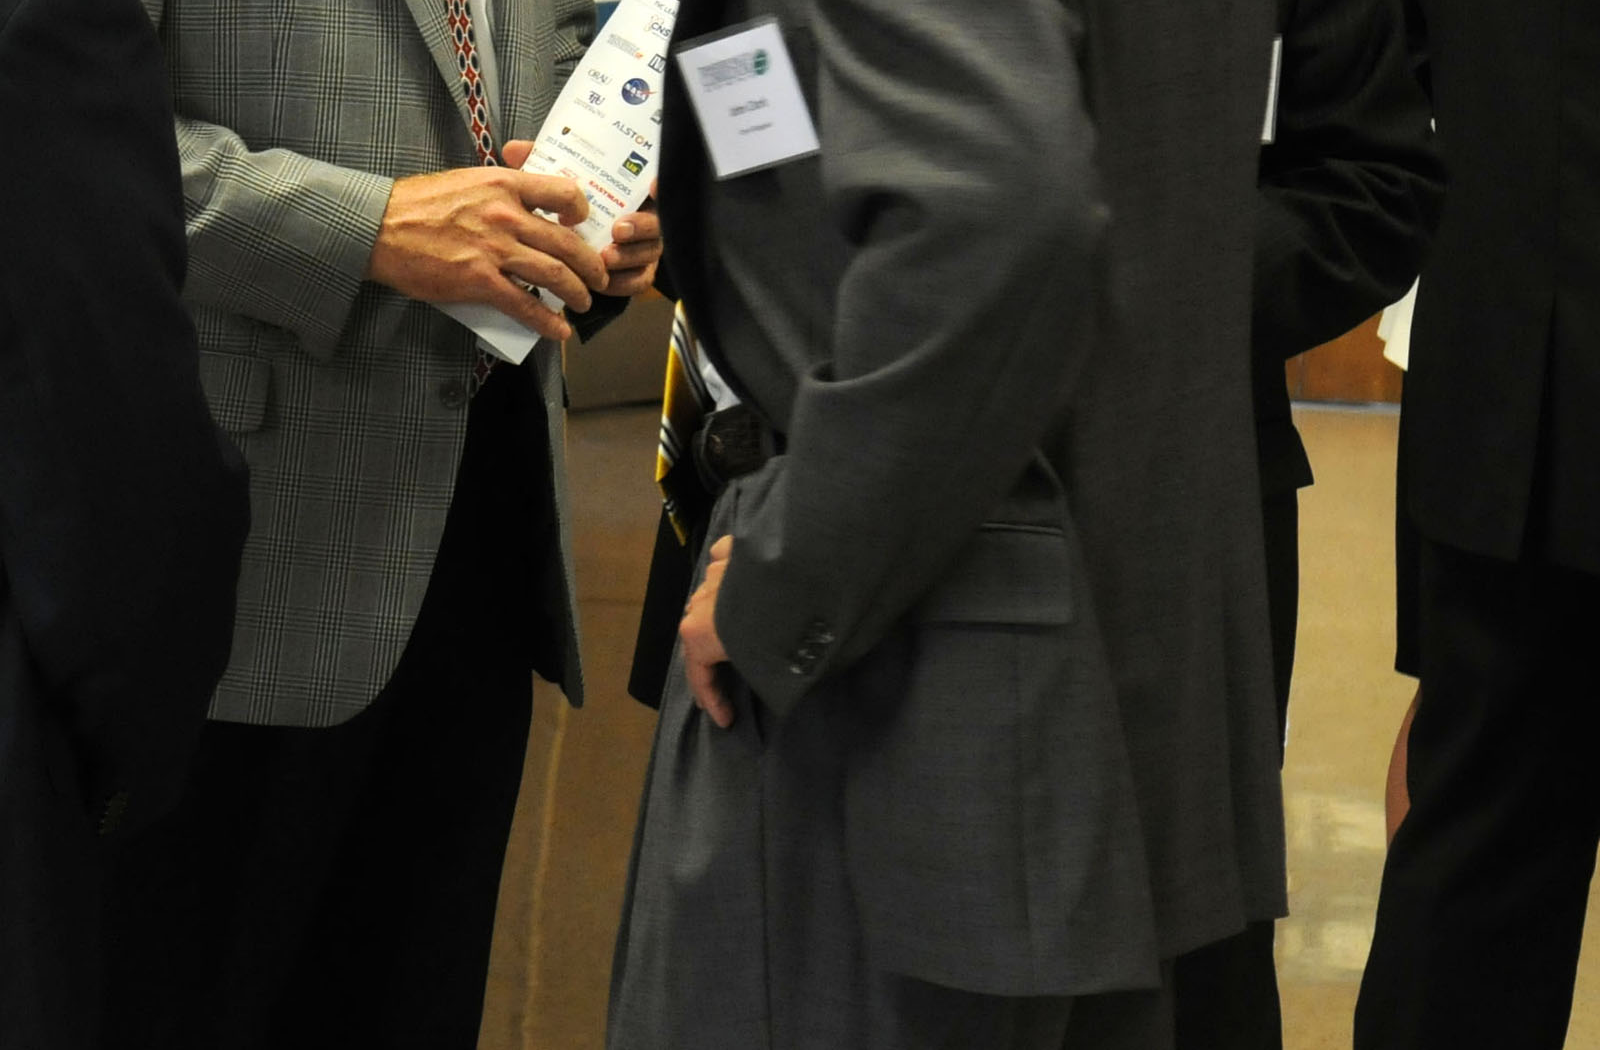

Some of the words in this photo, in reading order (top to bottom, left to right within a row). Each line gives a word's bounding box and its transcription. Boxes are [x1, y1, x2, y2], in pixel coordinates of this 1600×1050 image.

[651, 22, 672, 37] CNS
[624, 82, 646, 101] NASA
[612, 120, 653, 150] ALSTOM
[588, 180, 625, 208] EASTMAN
[599, 169, 632, 196] SPONSORS
